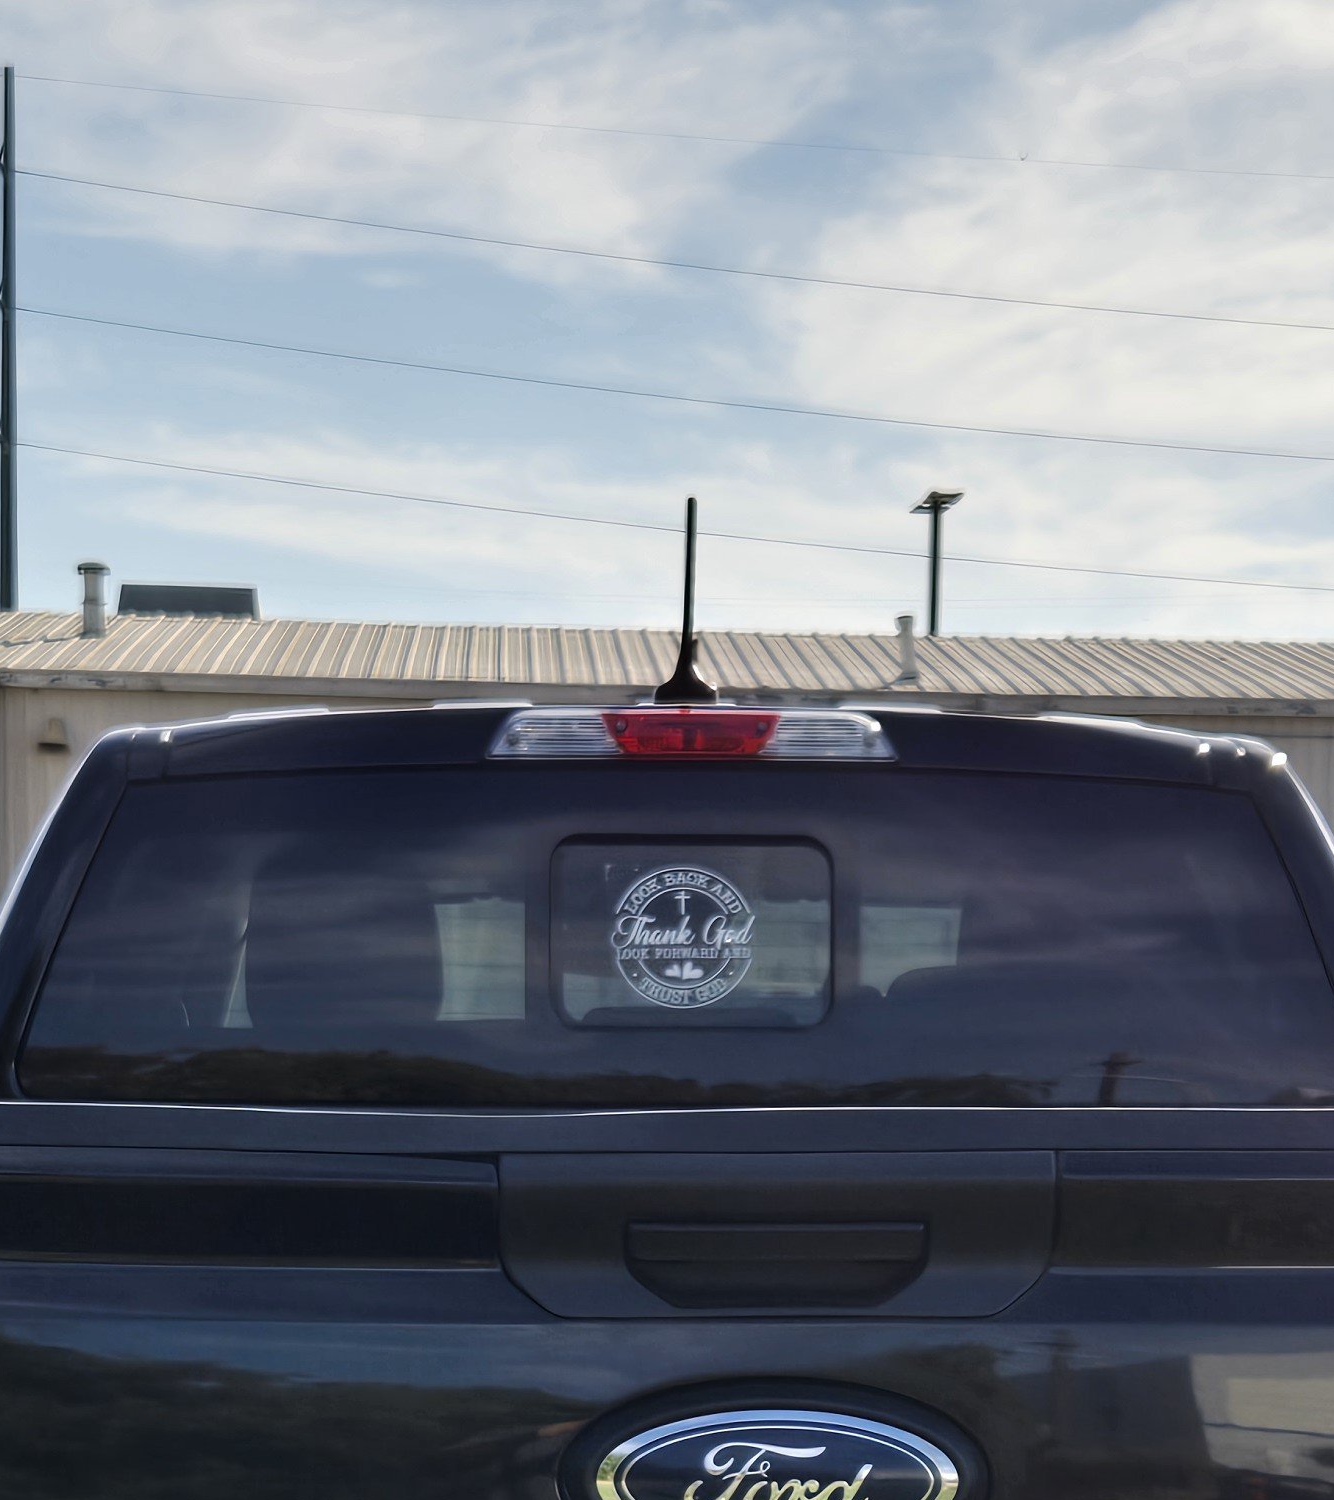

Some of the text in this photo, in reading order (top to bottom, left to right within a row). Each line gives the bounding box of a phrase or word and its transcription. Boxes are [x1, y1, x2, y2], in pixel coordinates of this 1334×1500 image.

[624, 872, 743, 914] LOOK BACK AND
[611, 915, 756, 951] Thank God
[655, 948, 718, 959] FORWARD
[638, 976, 727, 1004] TRUST GOD
